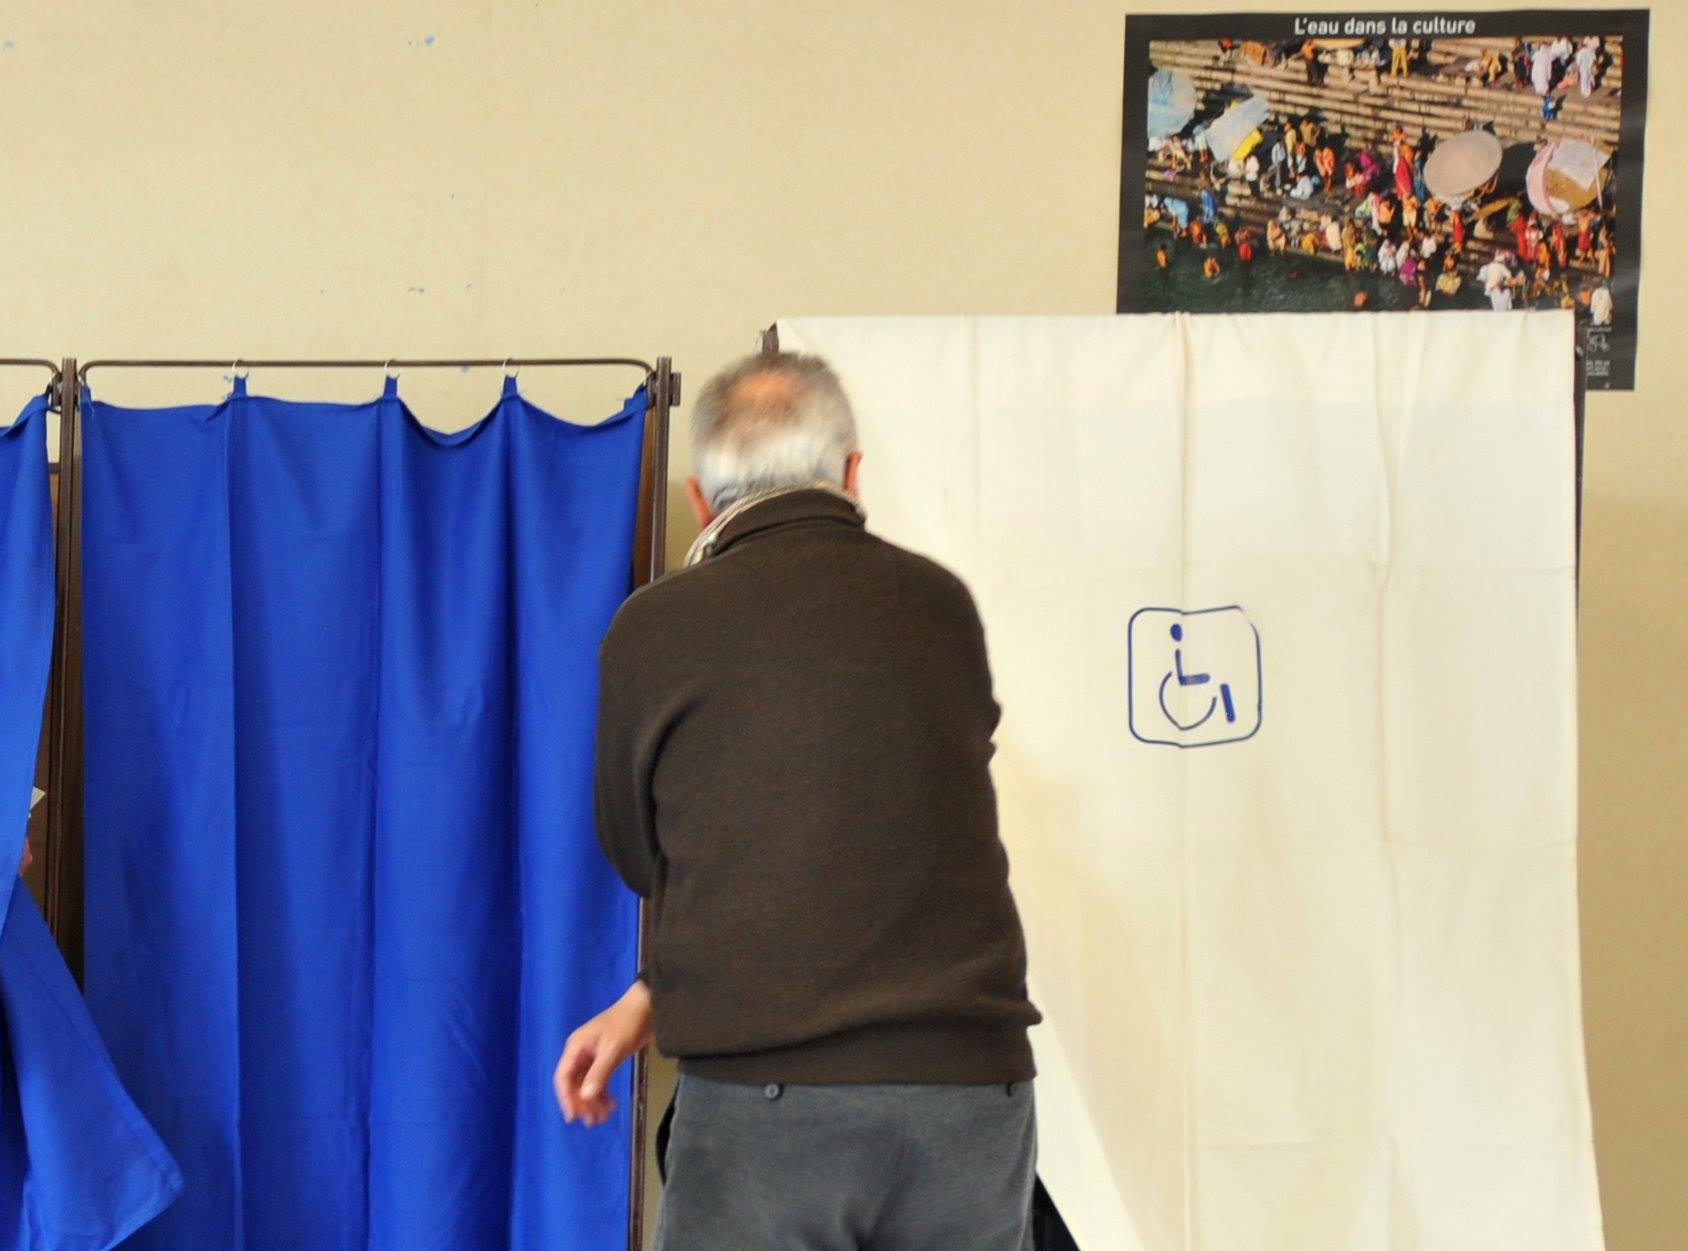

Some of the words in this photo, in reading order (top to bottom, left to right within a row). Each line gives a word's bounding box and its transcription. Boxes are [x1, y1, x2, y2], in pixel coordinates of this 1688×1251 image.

[1295, 17, 1339, 35] L'eau
[1344, 17, 1386, 35] dans
[1392, 17, 1408, 34] la
[1413, 16, 1476, 34] culture
